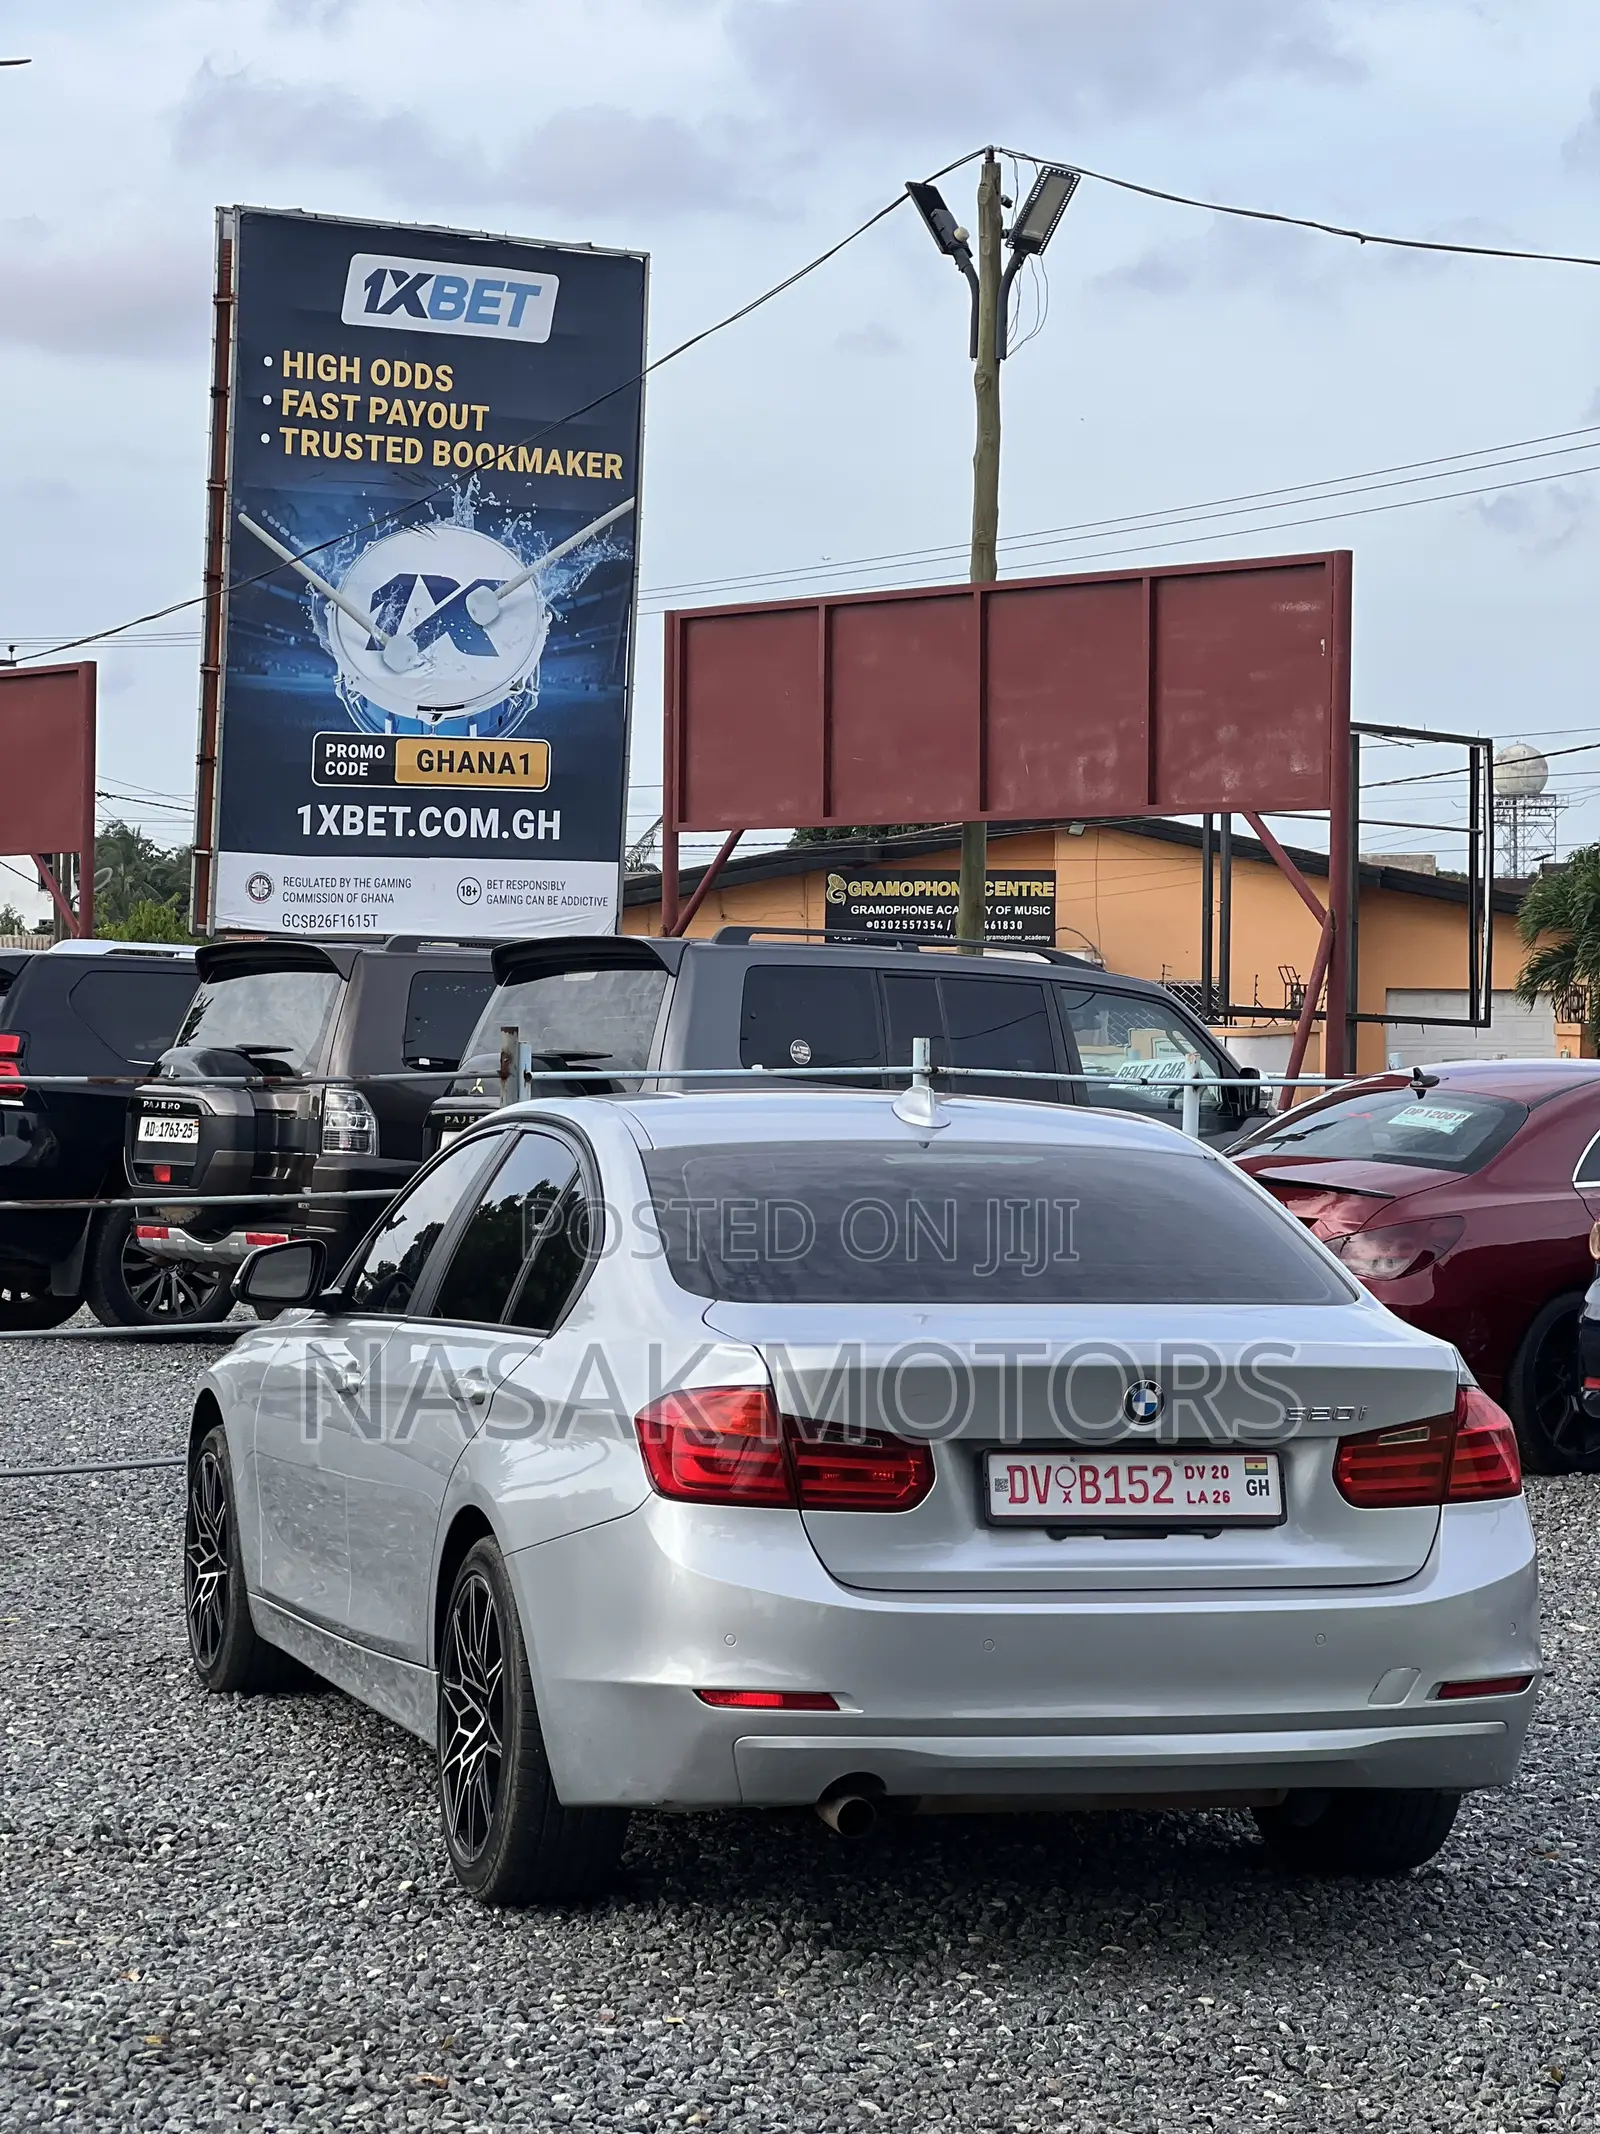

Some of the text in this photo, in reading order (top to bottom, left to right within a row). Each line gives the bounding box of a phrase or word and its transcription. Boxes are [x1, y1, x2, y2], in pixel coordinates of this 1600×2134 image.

[363, 268, 542, 328] 1XBET
[283, 349, 454, 392] HIGH ODDS
[281, 389, 490, 432] FAST PAYOUT
[279, 426, 623, 480] TRUSTED BOOKMAKER
[325, 743, 386, 760] PROMO
[324, 760, 369, 777] CODE
[416, 748, 531, 776] GHANA1
[297, 804, 561, 840] 1XBET.COM.GH
[283, 876, 412, 889] REGULATED BY THE GAMING
[461, 885, 478, 897] 18+
[487, 879, 566, 891] BET RESPONSIBLY
[848, 880, 1055, 897] GRAMOPHON CENTRE
[283, 891, 395, 904] COMMISSION OF GHANA
[487, 894, 609, 907] GAMING CAN BE ADDICTIVE
[851, 905, 934, 915] GRAMOPHONE
[996, 905, 1012, 915] OF
[1015, 905, 1051, 915] MUSIC
[282, 913, 378, 928] GCSB26F1615T
[874, 920, 944, 930] 0302557354
[986, 934, 1051, 942] gramophone_academy
[1118, 1061, 1186, 1079] RENT A CAR
[143, 1100, 181, 1110] PAJERO
[144, 1121, 156, 1137] AD
[158, 1122, 194, 1138] 1763-25
[1184, 1464, 1230, 1480] DV 20
[1006, 1464, 1052, 1504] DV
[1079, 1464, 1175, 1504] B152
[1245, 1478, 1271, 1497] GH
[1186, 1489, 1231, 1504] LA 26
